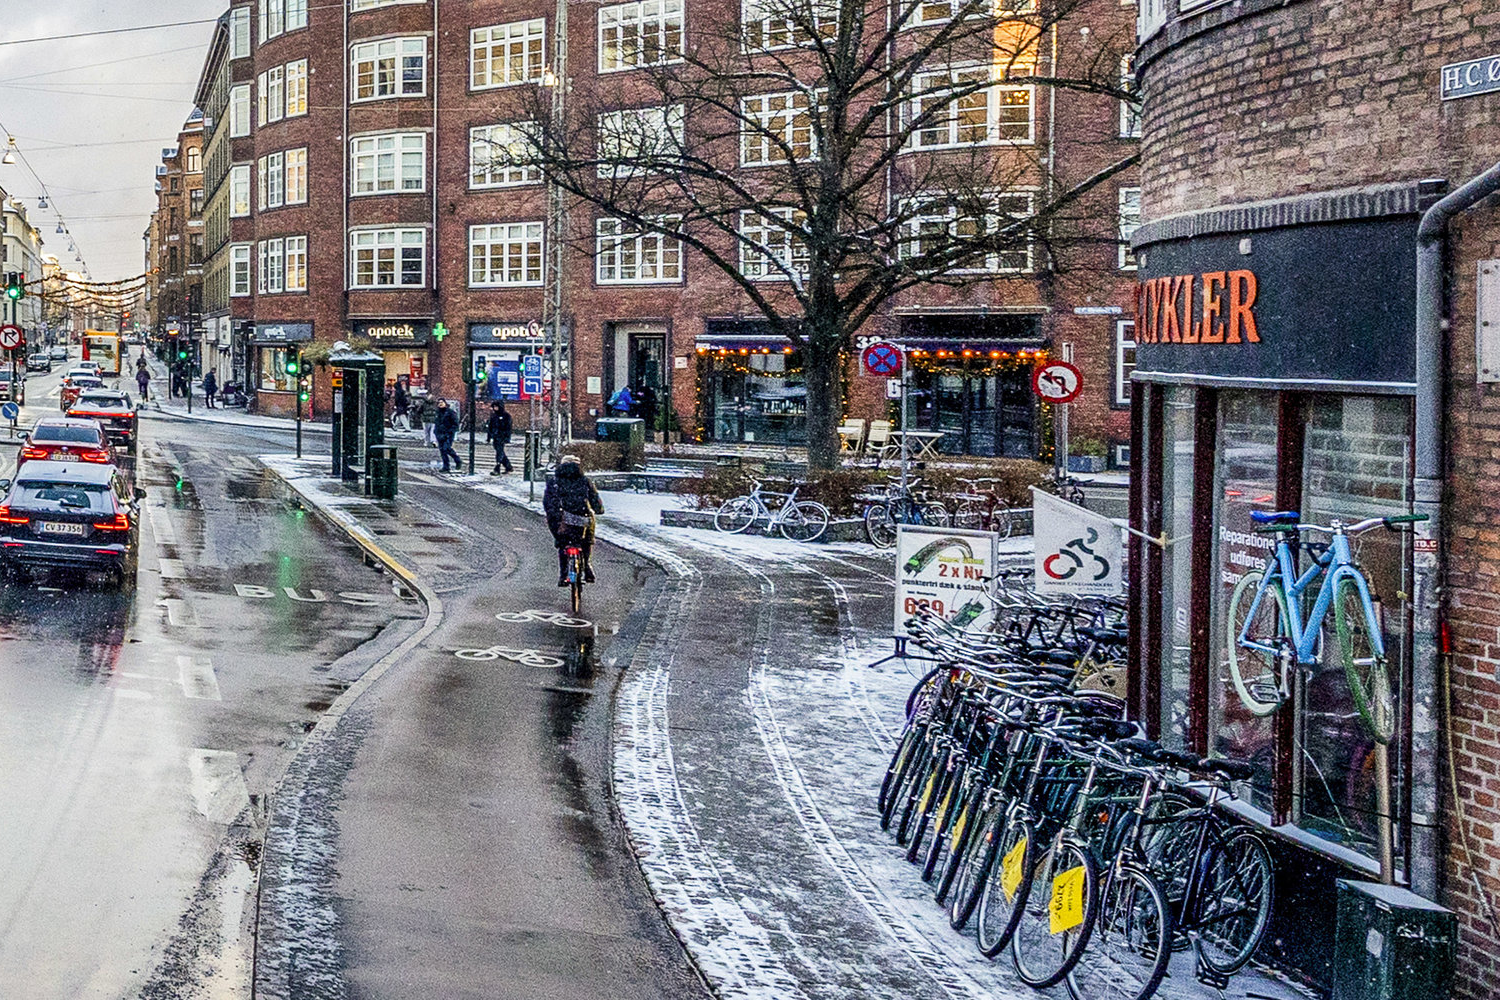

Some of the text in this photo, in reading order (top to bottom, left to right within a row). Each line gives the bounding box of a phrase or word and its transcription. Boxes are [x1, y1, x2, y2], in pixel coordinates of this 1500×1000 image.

[367, 324, 414, 339] apotek
[491, 325, 545, 340] apot
[45, 523, 55, 531] CV
[67, 525, 82, 533] 356
[1219, 525, 1275, 550] Reparatione
[1230, 550, 1266, 570] udføres
[938, 563, 984, 581] 2 x Ny
